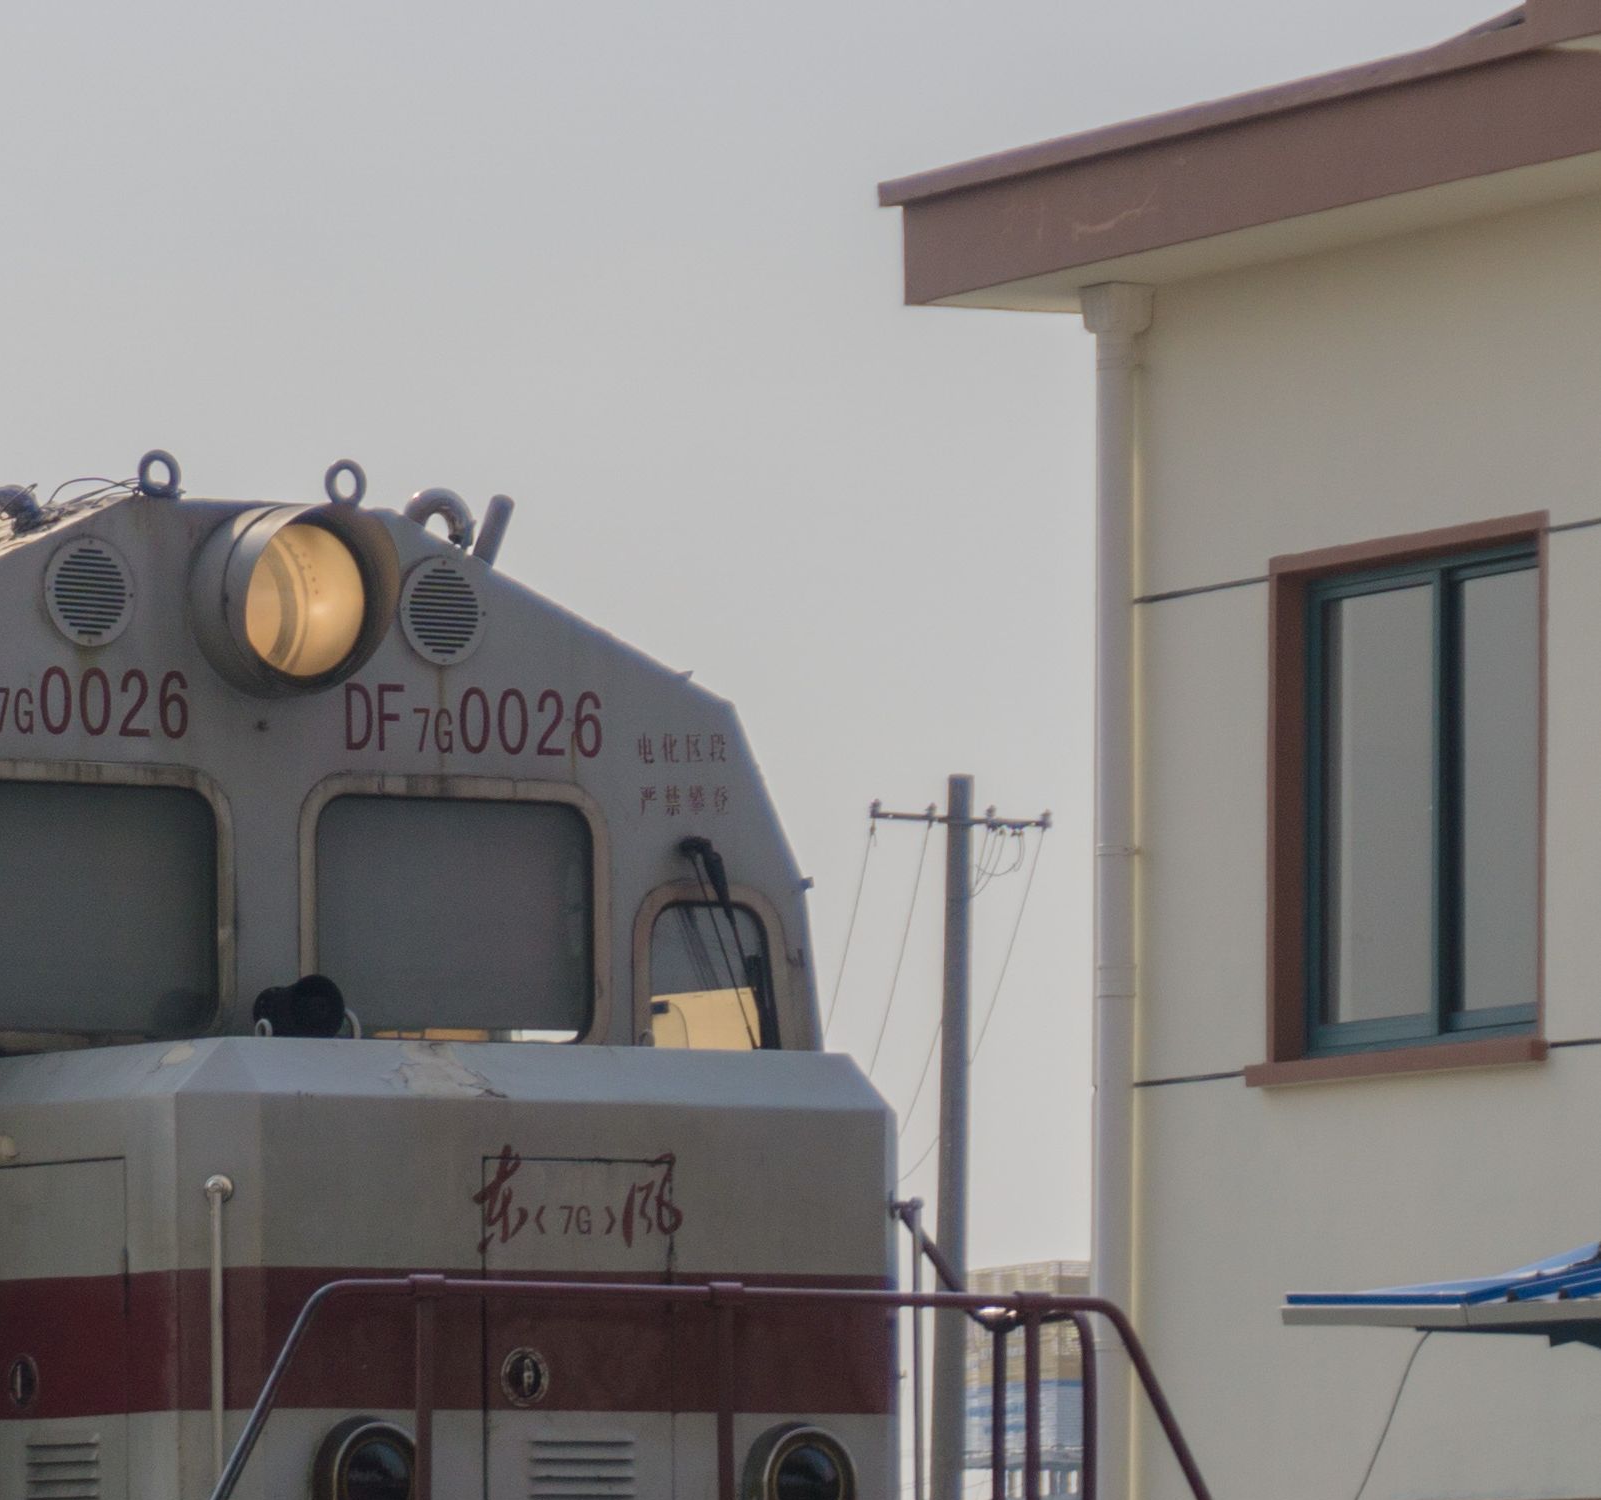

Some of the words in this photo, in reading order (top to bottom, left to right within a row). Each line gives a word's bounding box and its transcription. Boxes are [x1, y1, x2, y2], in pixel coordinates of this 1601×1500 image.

[637, 732, 728, 764] 电化区段
[639, 785, 730, 817] 严禁攀登
